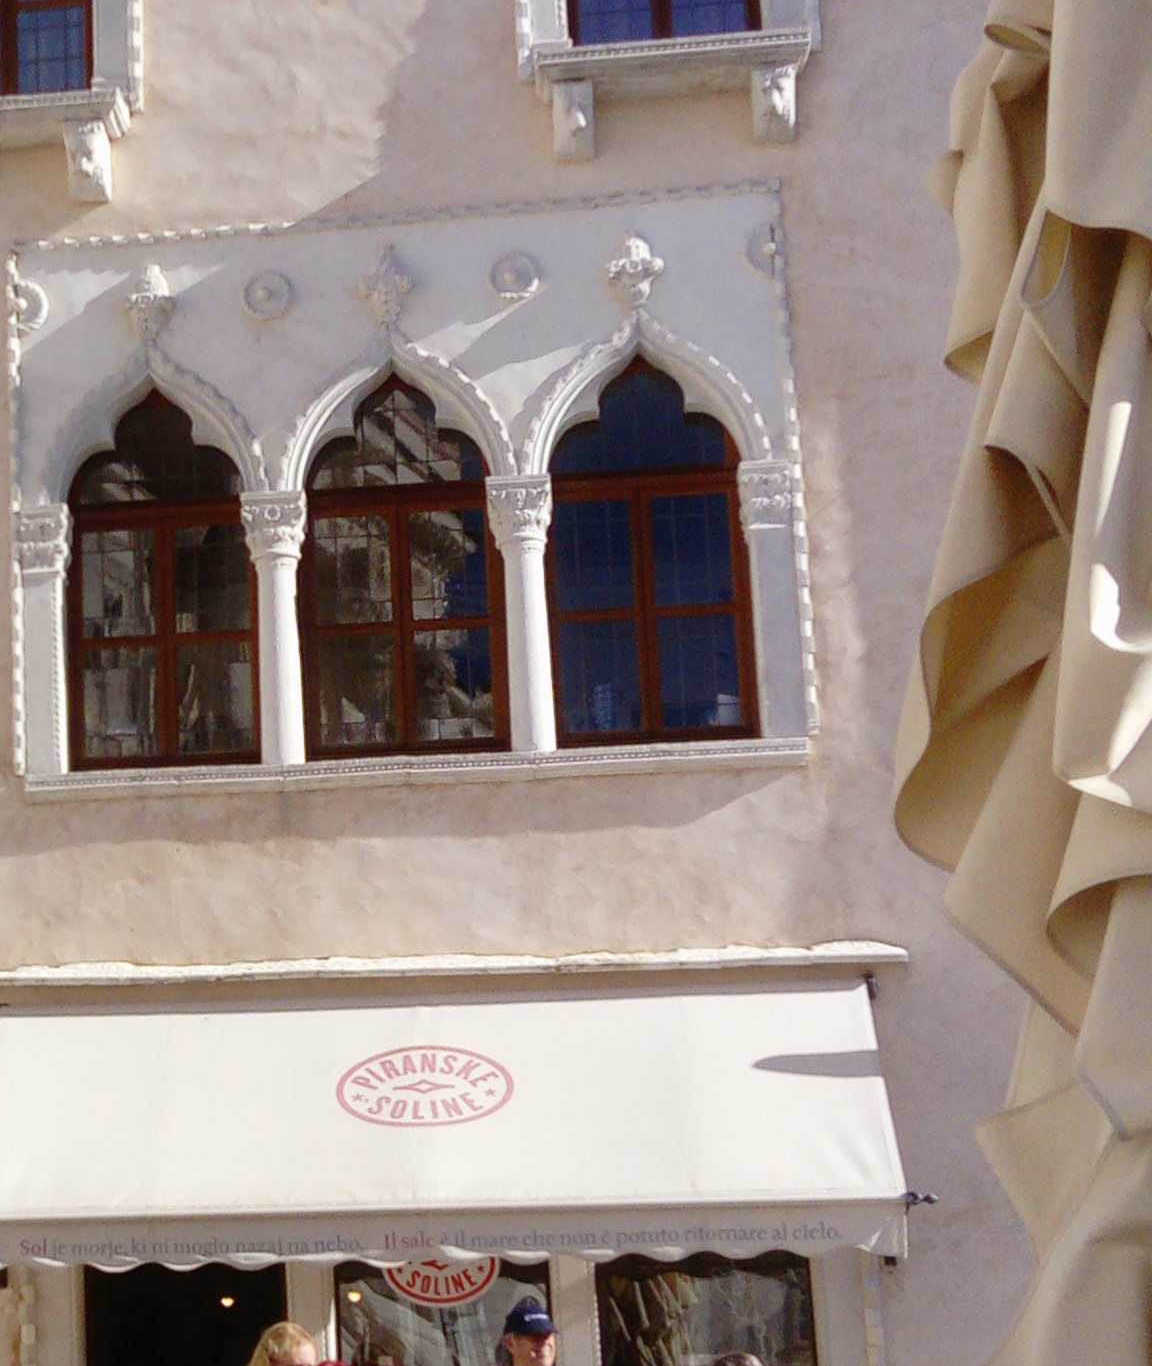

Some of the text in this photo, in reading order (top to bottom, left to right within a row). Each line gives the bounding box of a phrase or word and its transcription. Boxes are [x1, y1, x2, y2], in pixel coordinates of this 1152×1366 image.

[349, 1053, 500, 1092] PIRANSKE
[367, 1091, 484, 1120] SOLINE
[20, 1234, 364, 1259] Sol je morje, ki ni moglo nazaj na nebo.
[384, 1228, 397, 1249] Il
[401, 1230, 436, 1249] sale
[454, 1229, 466, 1247] il
[471, 1233, 519, 1248] mare
[522, 1228, 555, 1247] che
[559, 1230, 597, 1246] non
[600, 1228, 611, 1245] è
[615, 1227, 680, 1249] potuto
[684, 1225, 768, 1242] ritornare
[771, 1221, 789, 1241] al
[792, 1220, 844, 1241] cielo.
[406, 1268, 477, 1296] SOLINE
